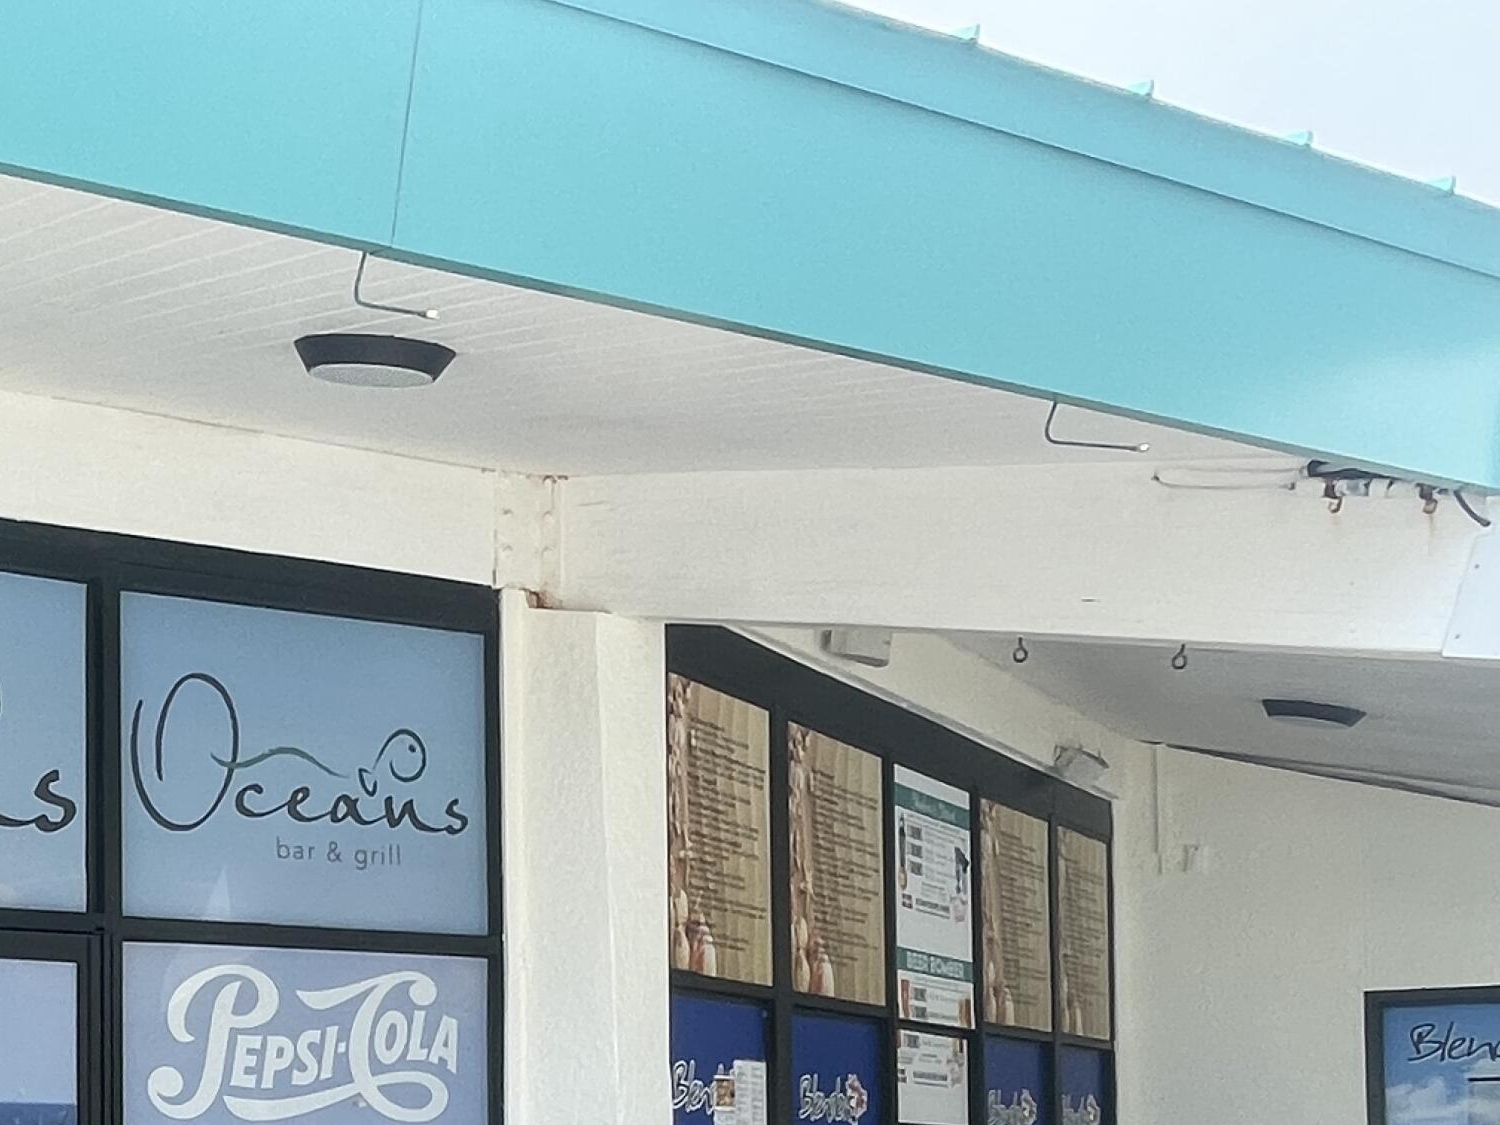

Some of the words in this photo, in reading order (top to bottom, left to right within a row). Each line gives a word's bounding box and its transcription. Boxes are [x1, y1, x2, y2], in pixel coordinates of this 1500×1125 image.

[130, 672, 469, 834] Oceans
[276, 837, 317, 860] bar
[326, 841, 344, 863] &
[354, 844, 402, 871] grill
